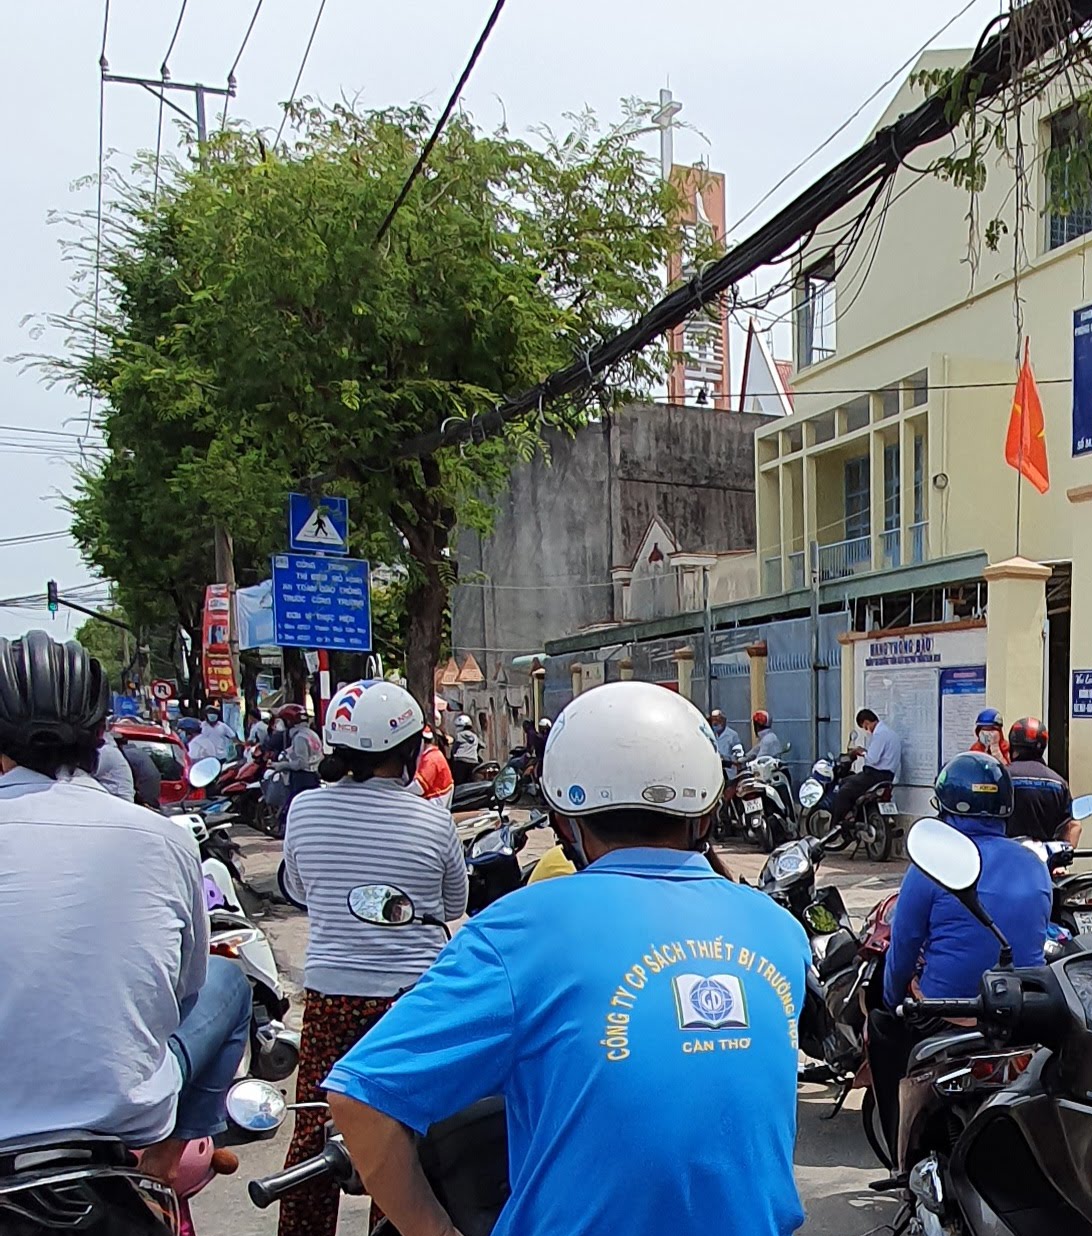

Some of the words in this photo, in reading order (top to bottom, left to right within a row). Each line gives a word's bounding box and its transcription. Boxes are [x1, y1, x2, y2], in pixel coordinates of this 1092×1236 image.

[643, 943, 687, 973] SÁCH
[686, 935, 734, 961] THIẾT
[623, 964, 649, 990] CP
[611, 986, 638, 1010] TY
[600, 1012, 631, 1062] CÔNG
